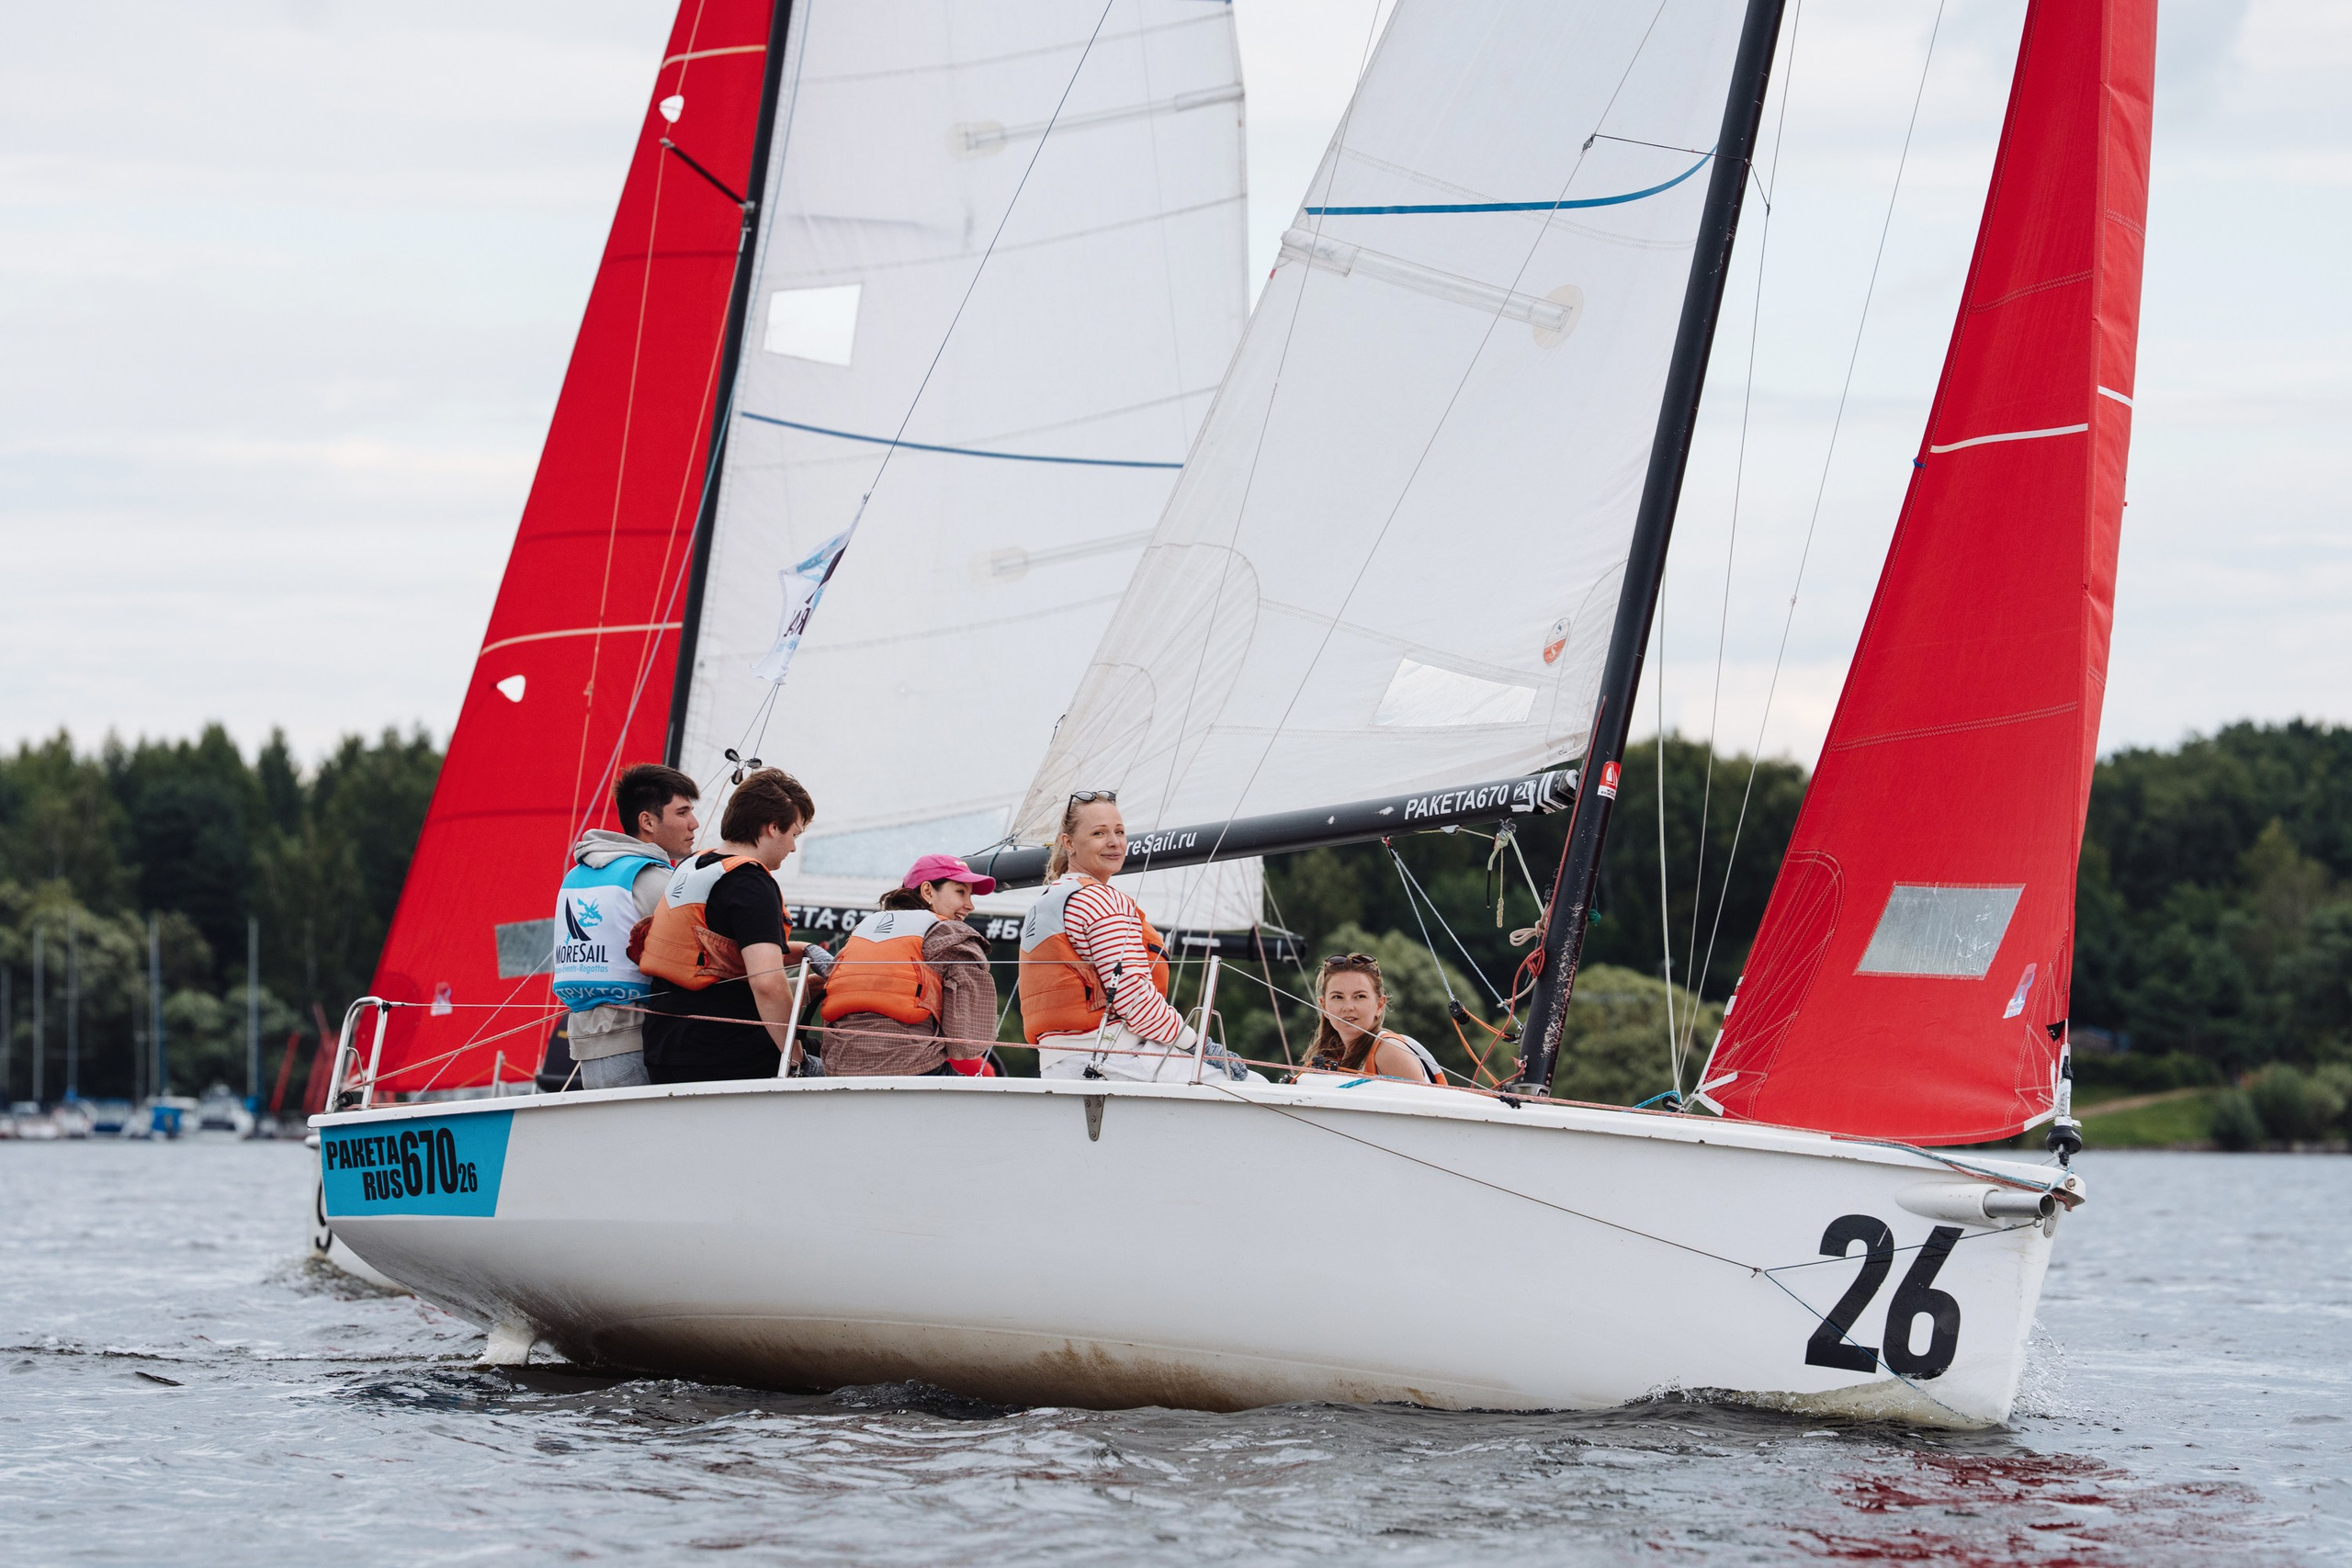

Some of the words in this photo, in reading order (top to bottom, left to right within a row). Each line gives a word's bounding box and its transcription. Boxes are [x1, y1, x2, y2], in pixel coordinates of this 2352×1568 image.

[1404, 784, 1510, 820] PAKETA670
[1125, 830, 1198, 857] reSail.ru
[362, 1168, 403, 1201] RUS
[458, 1162, 478, 1193] 26
[1804, 1213, 1965, 1381] 26
